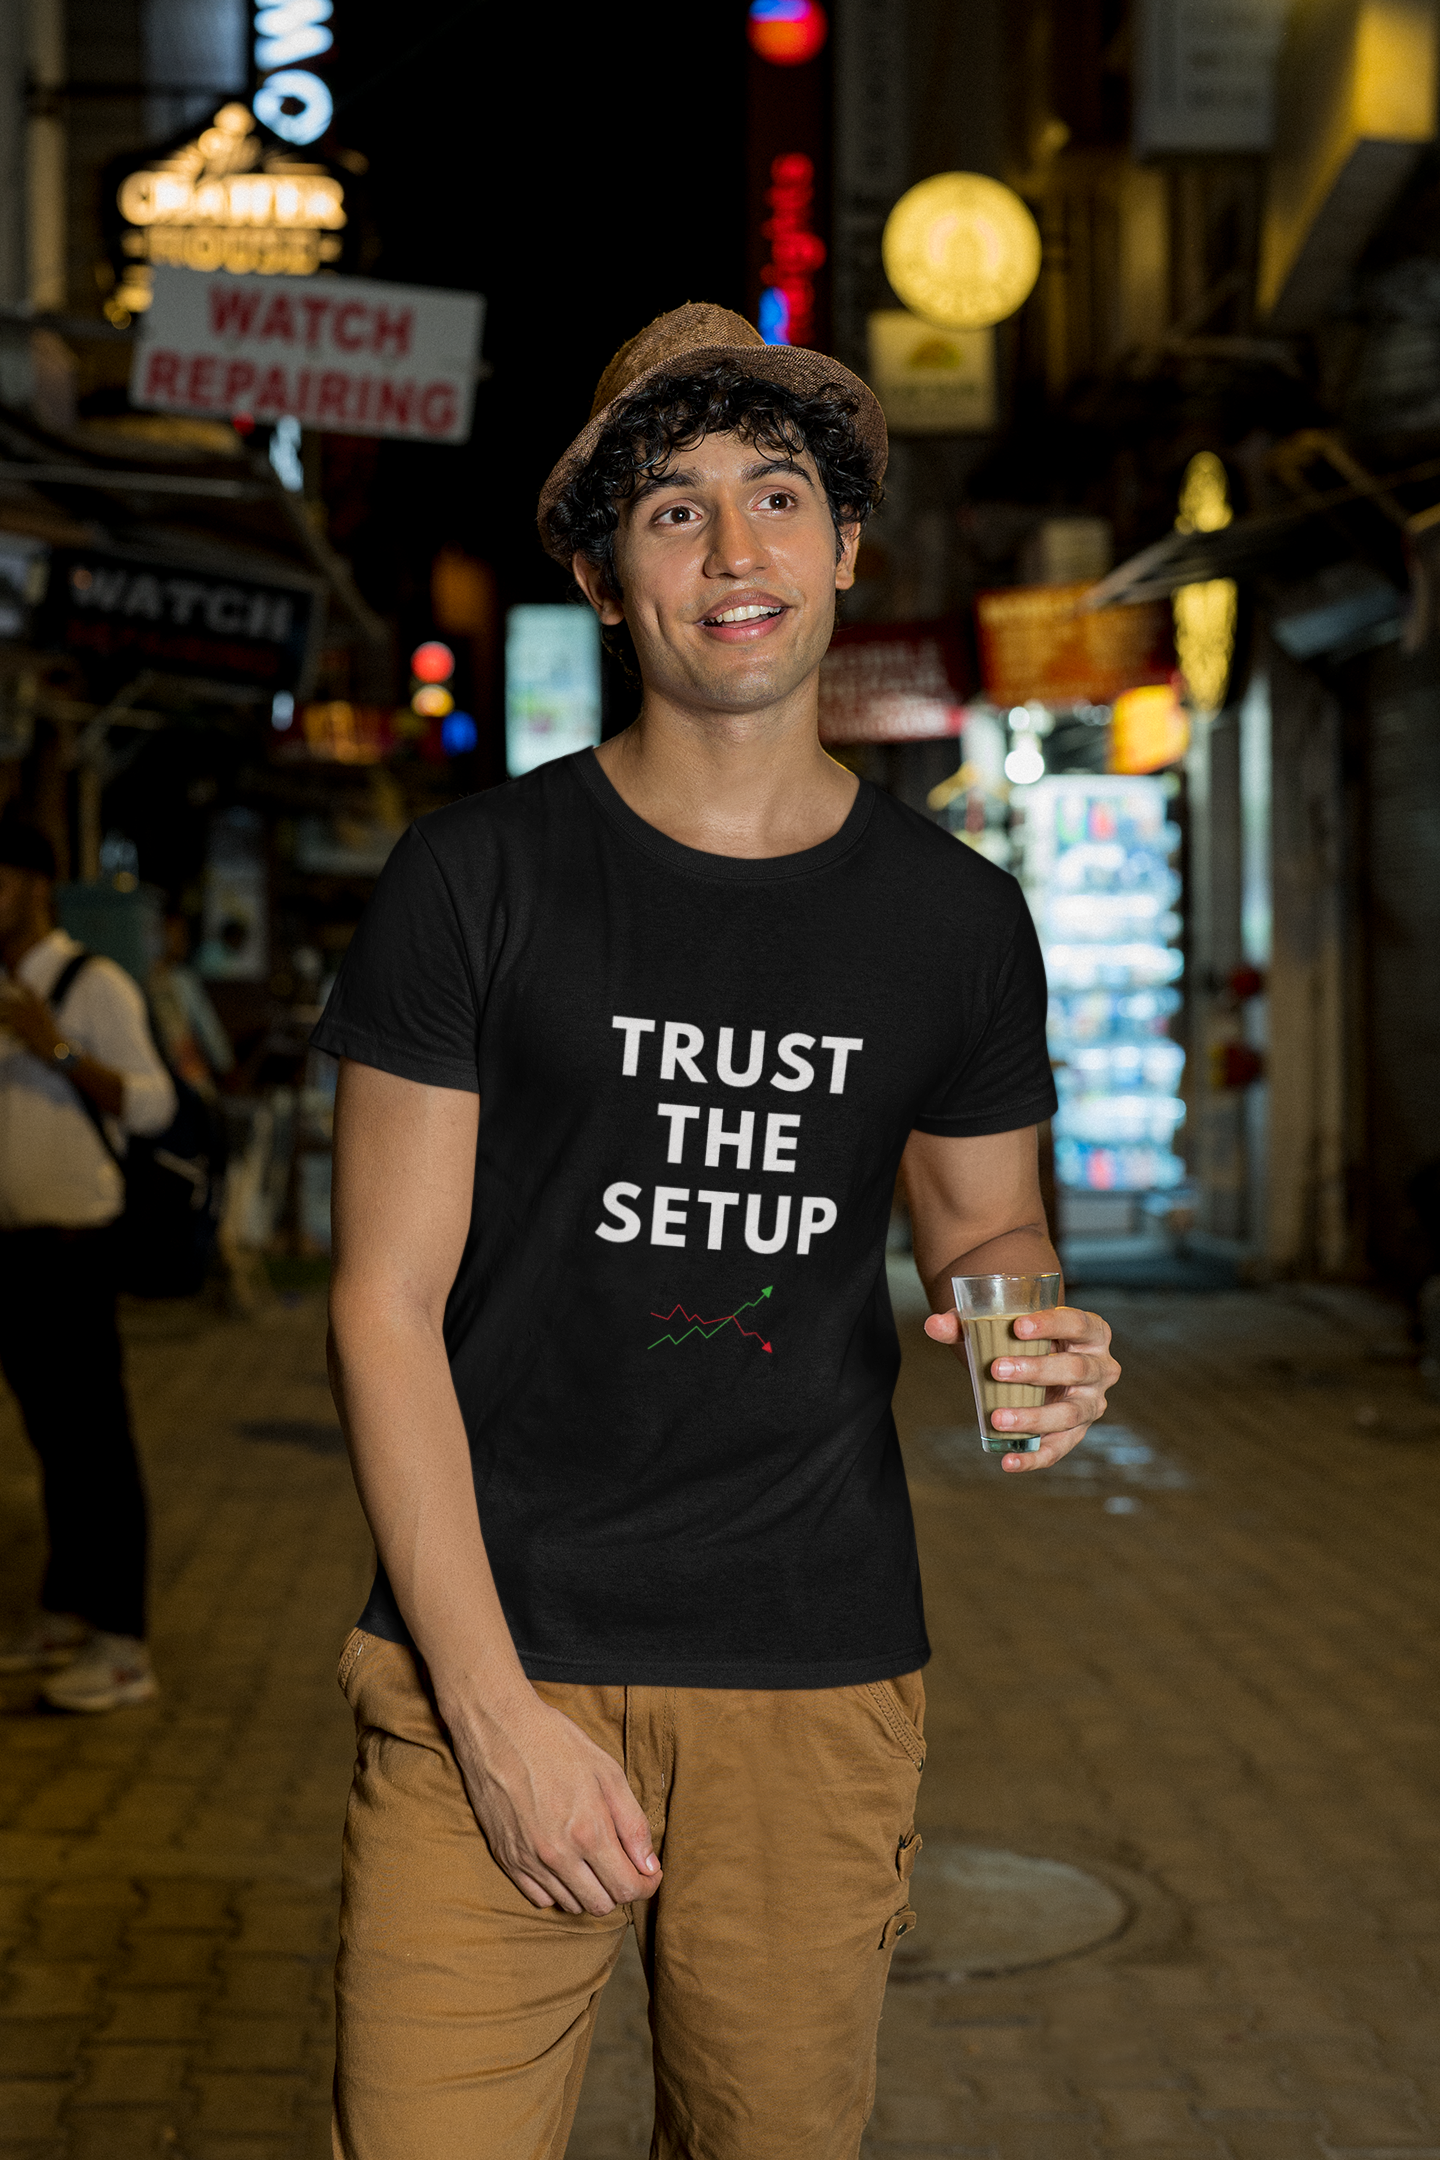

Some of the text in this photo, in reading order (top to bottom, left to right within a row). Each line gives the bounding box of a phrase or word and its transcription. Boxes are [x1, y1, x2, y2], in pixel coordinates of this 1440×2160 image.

[207, 284, 414, 358] WATCH
[143, 349, 460, 437] REPAIRING
[69, 563, 295, 643] WATCH
[611, 1015, 864, 1095] TRUST
[657, 1102, 801, 1173] THE
[594, 1181, 838, 1256] SETUP
